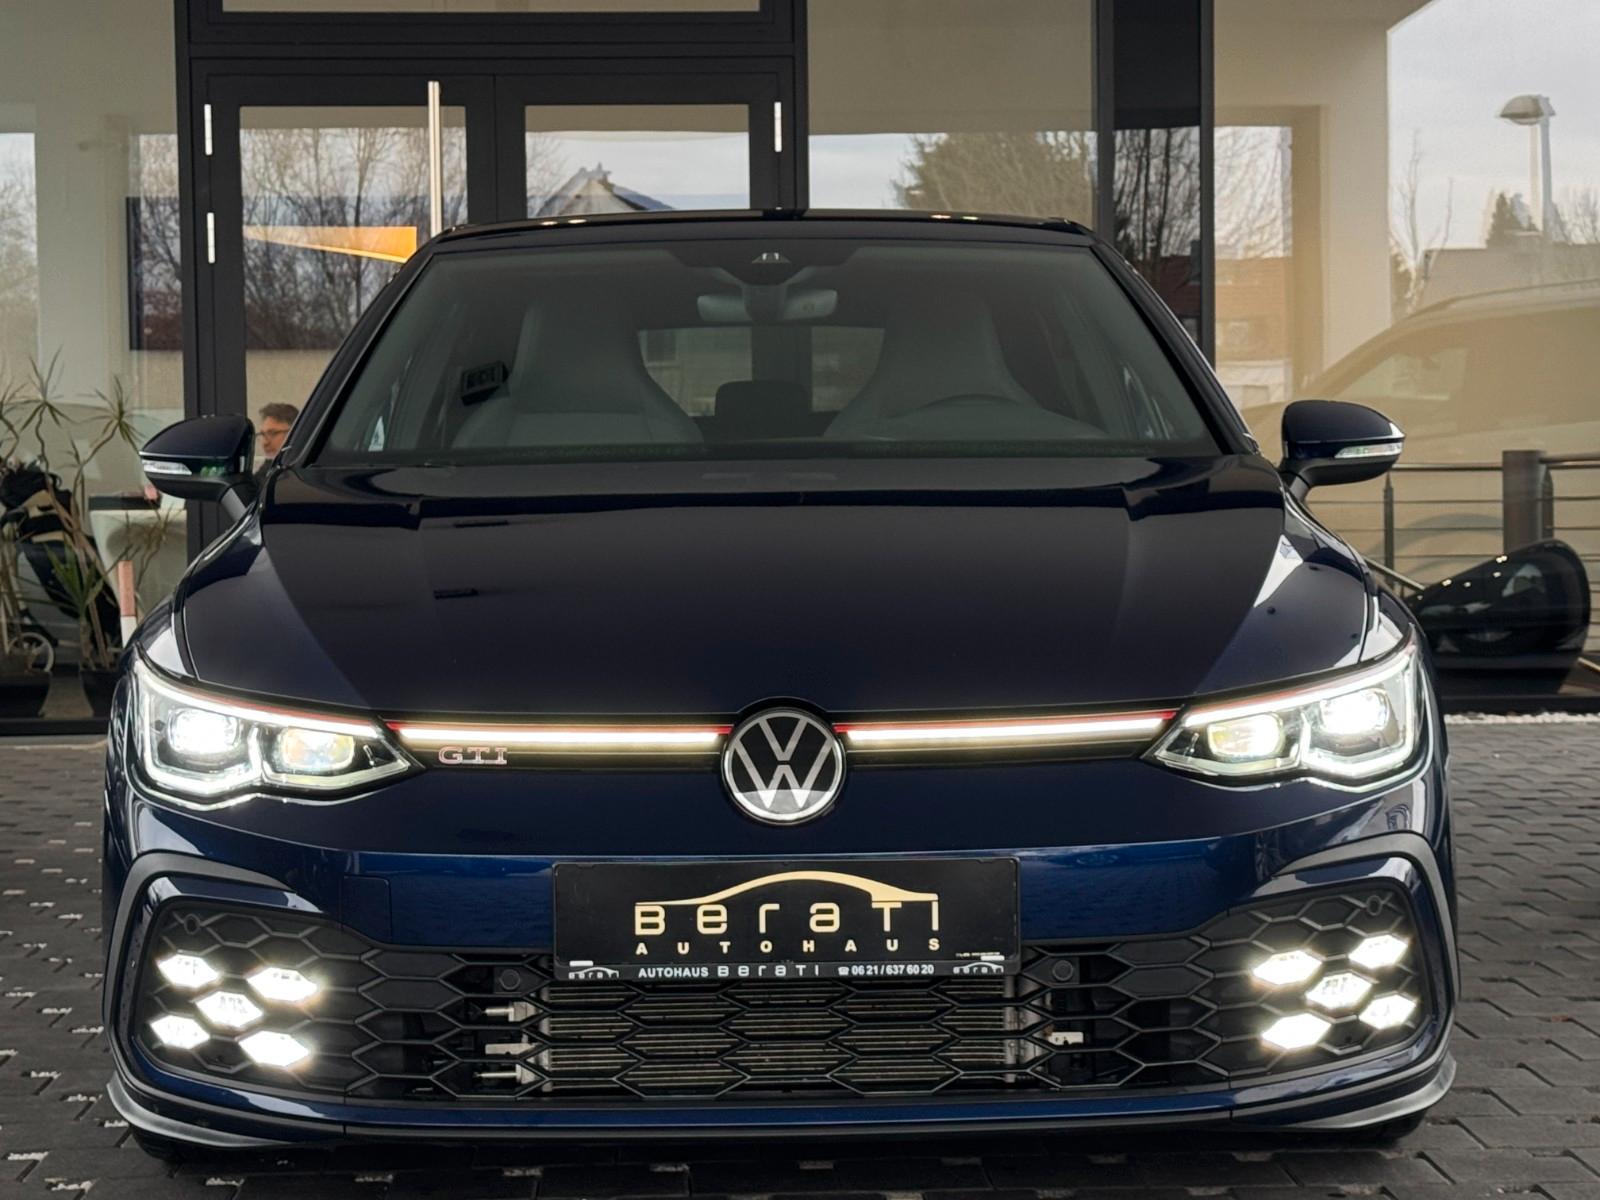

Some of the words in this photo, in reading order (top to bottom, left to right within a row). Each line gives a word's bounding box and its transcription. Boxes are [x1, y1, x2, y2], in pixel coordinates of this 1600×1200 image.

[438, 746, 508, 765] GTI
[635, 938, 940, 955] AUTOHAUS
[638, 967, 709, 978] AUTOHAUS
